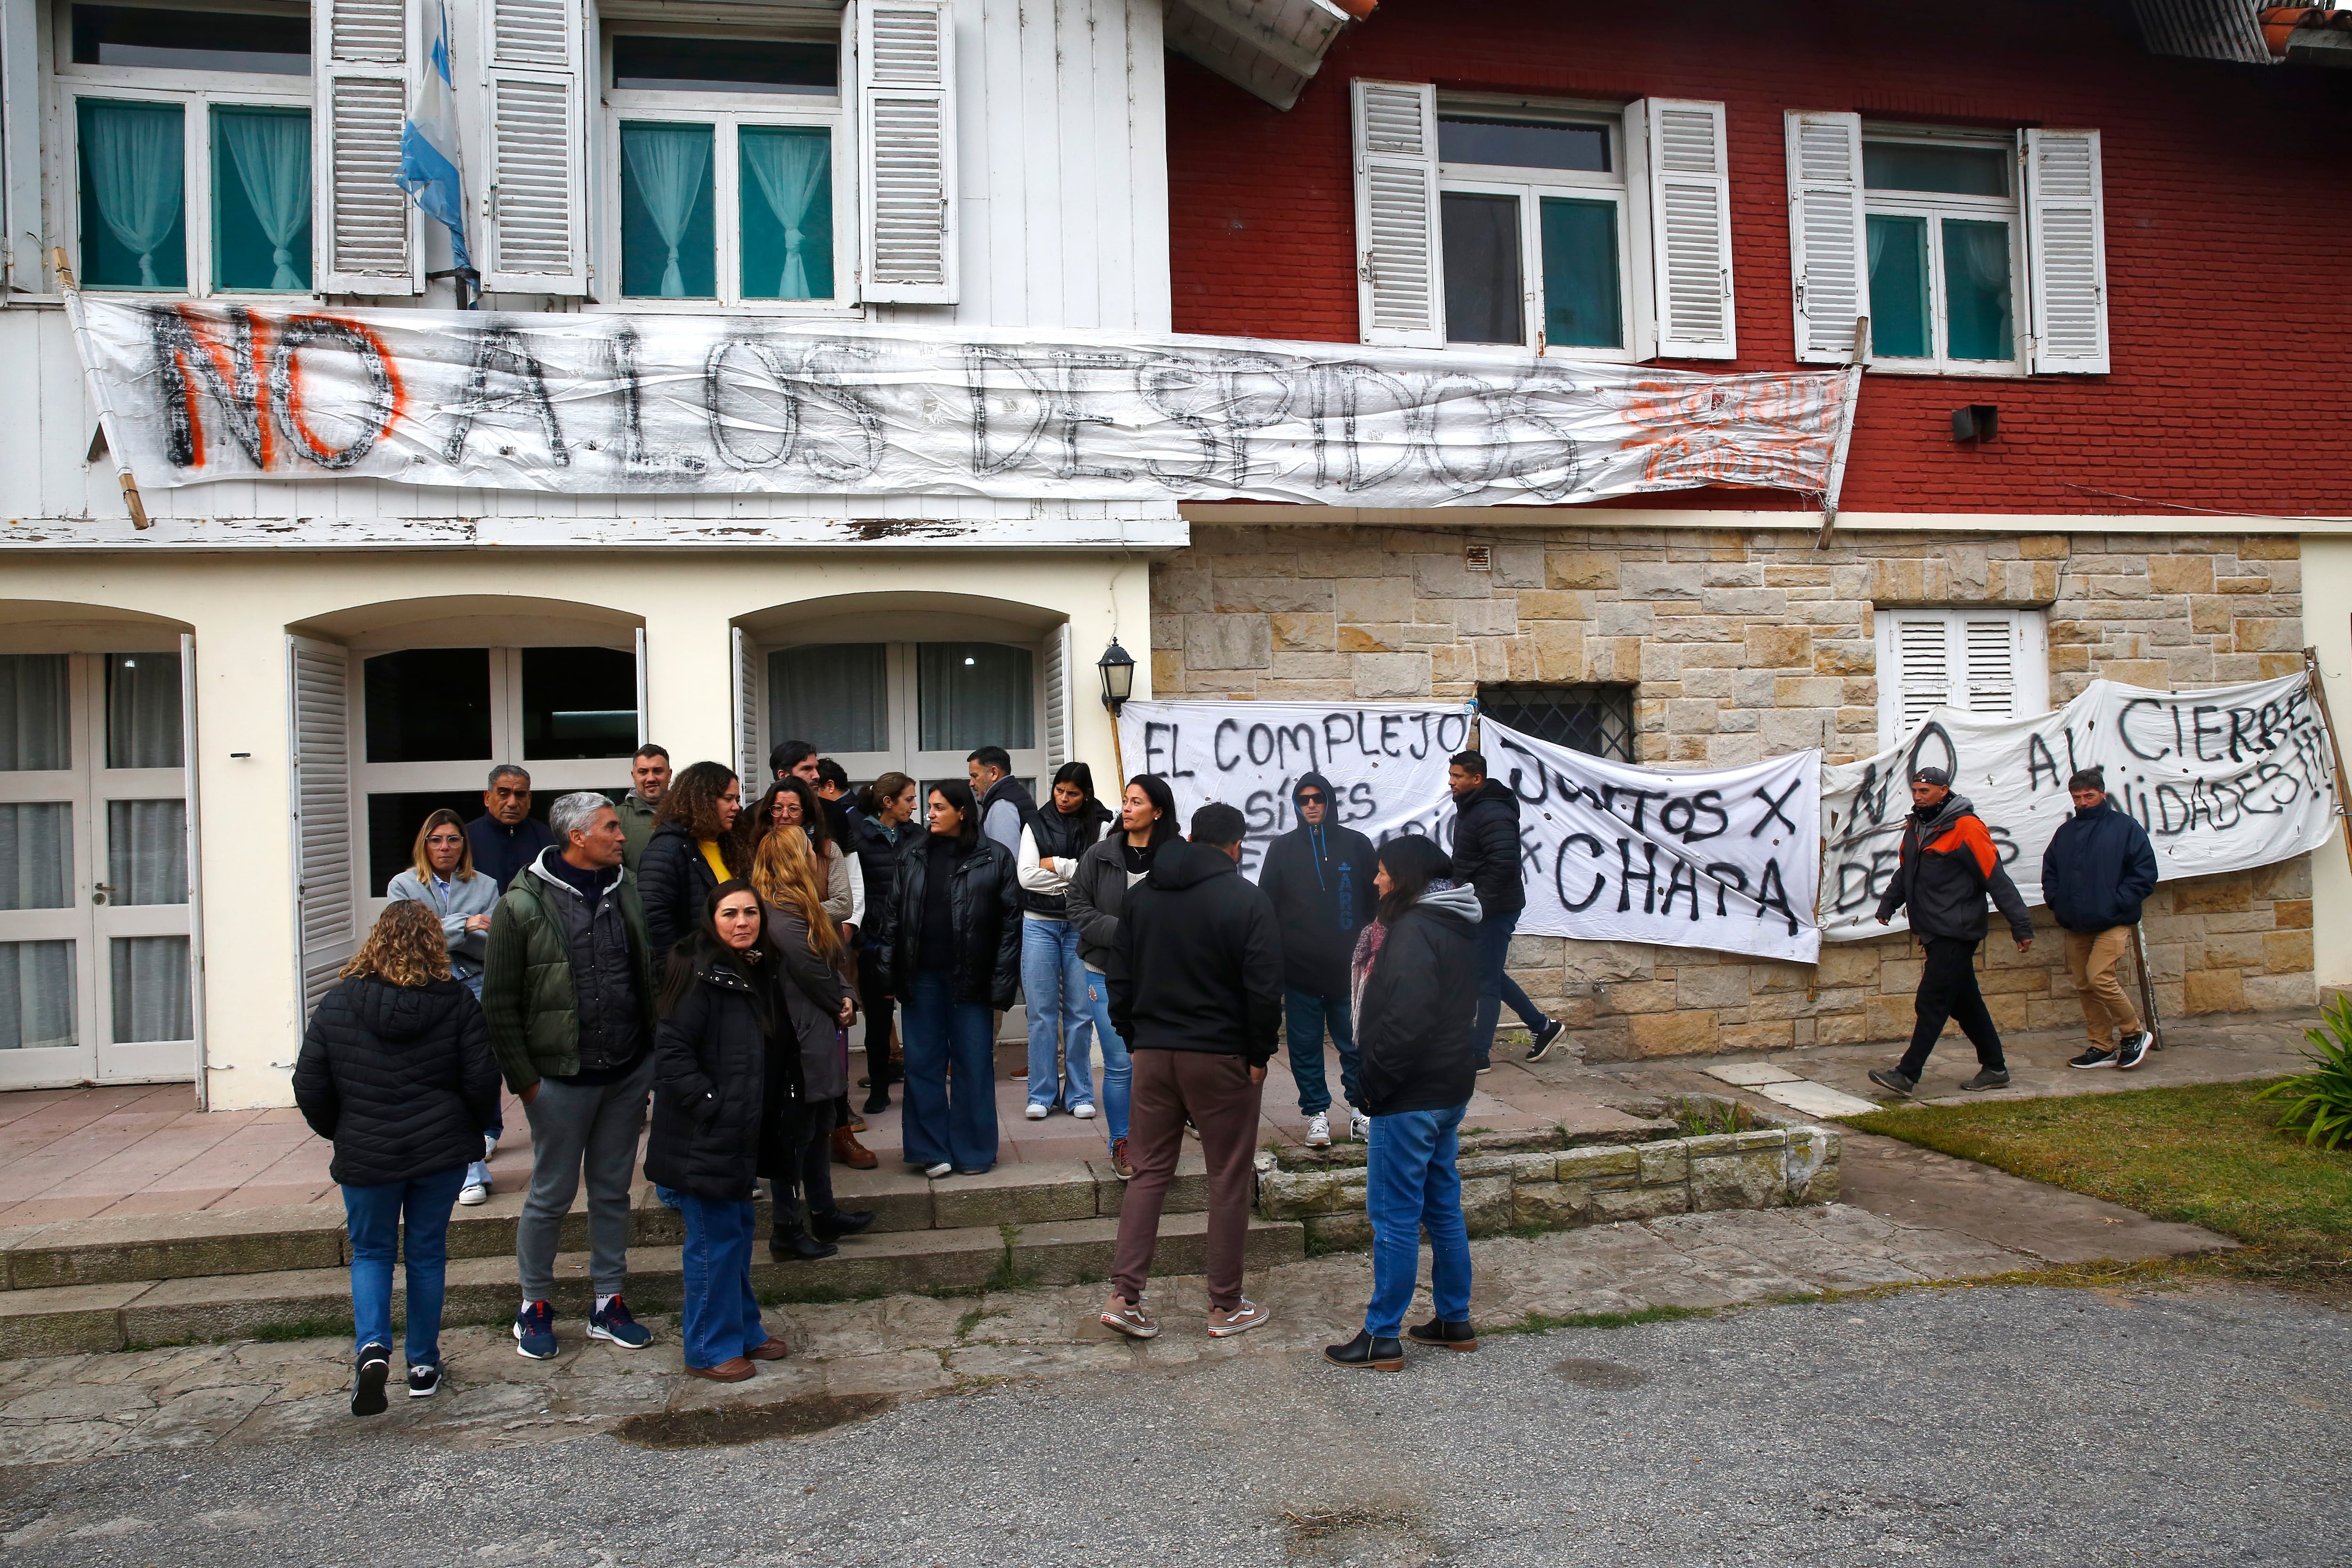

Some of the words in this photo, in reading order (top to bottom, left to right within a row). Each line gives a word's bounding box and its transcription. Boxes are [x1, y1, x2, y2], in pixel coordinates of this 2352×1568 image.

[153, 303, 408, 472] NO
[441, 324, 571, 467] A
[613, 324, 884, 481] LOS
[1144, 721, 1195, 778] EL
[1215, 711, 1466, 773] COMPLEJO
[1501, 737, 1728, 844] JUNTOS
[1751, 778, 1801, 837] X
[1843, 721, 1958, 836] NO
[2118, 688, 2312, 763] CIERRE
[1339, 873, 1353, 930] ARG
[1555, 832, 1798, 937] CHAPA
